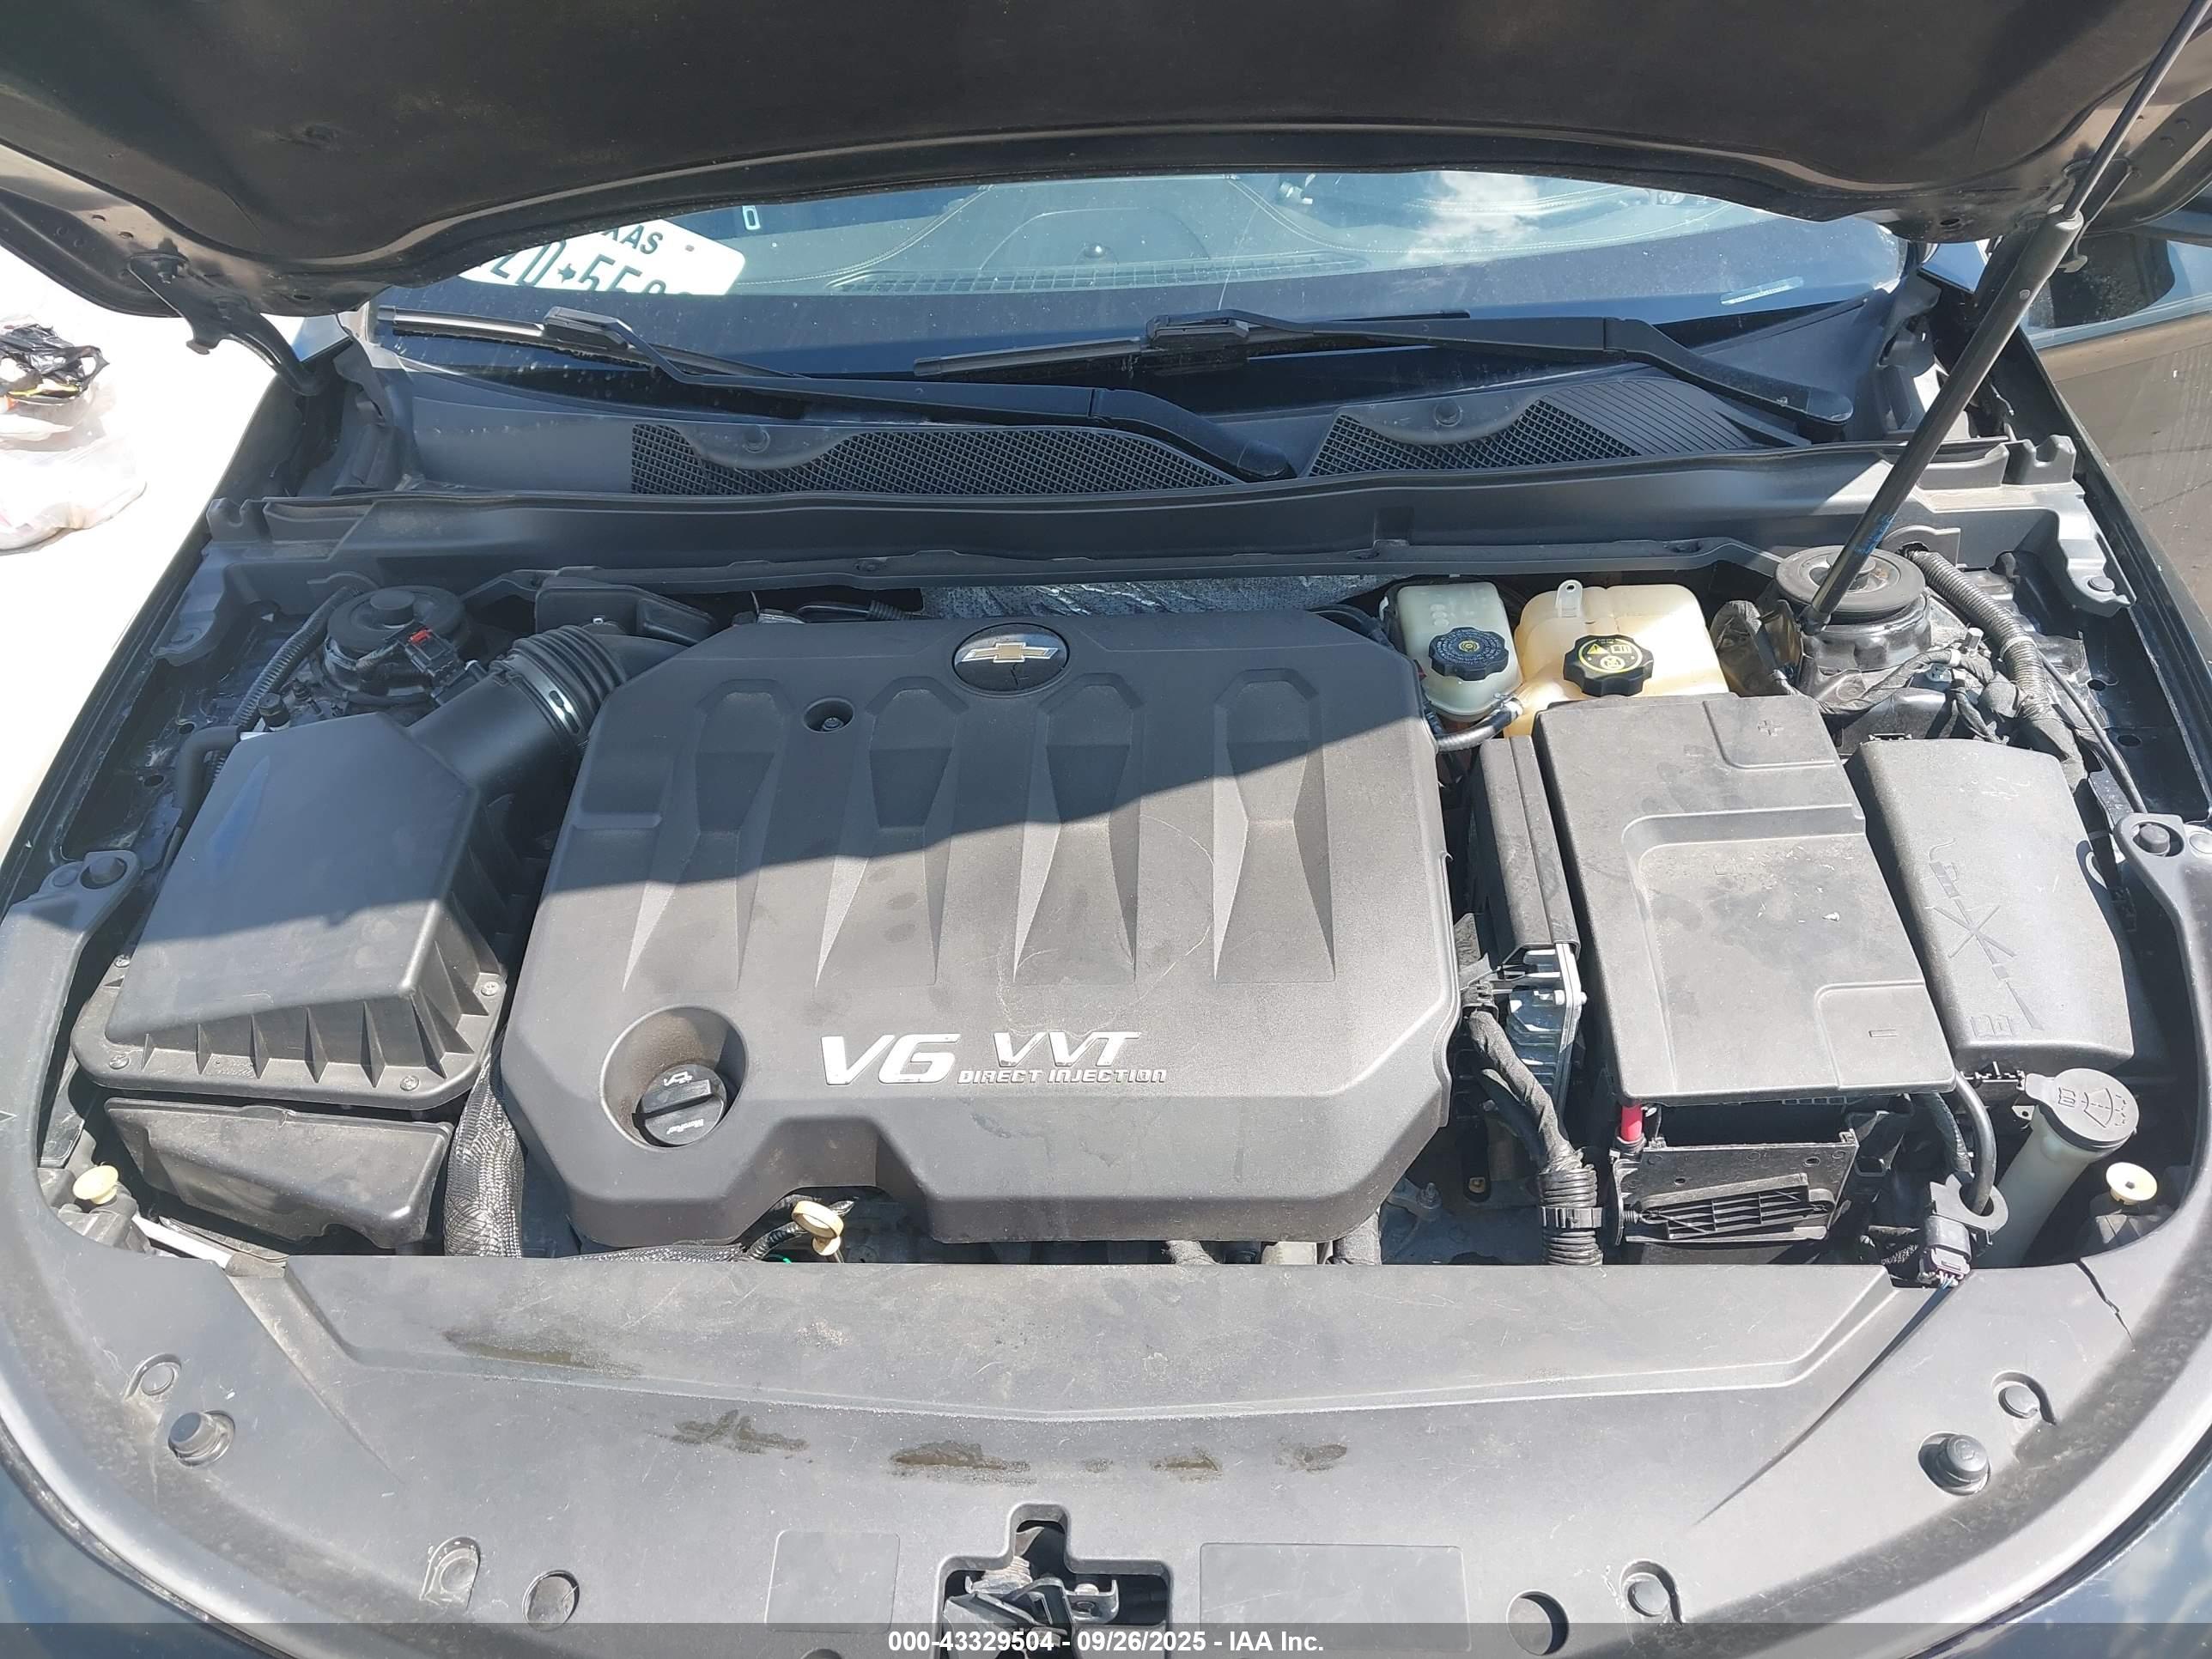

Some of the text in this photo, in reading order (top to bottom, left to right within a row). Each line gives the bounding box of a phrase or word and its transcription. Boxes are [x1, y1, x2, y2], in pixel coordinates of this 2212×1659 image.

[820, 1031, 1142, 1085] V6 VVT
[957, 1069, 1168, 1085] DIRECT INJECTION
